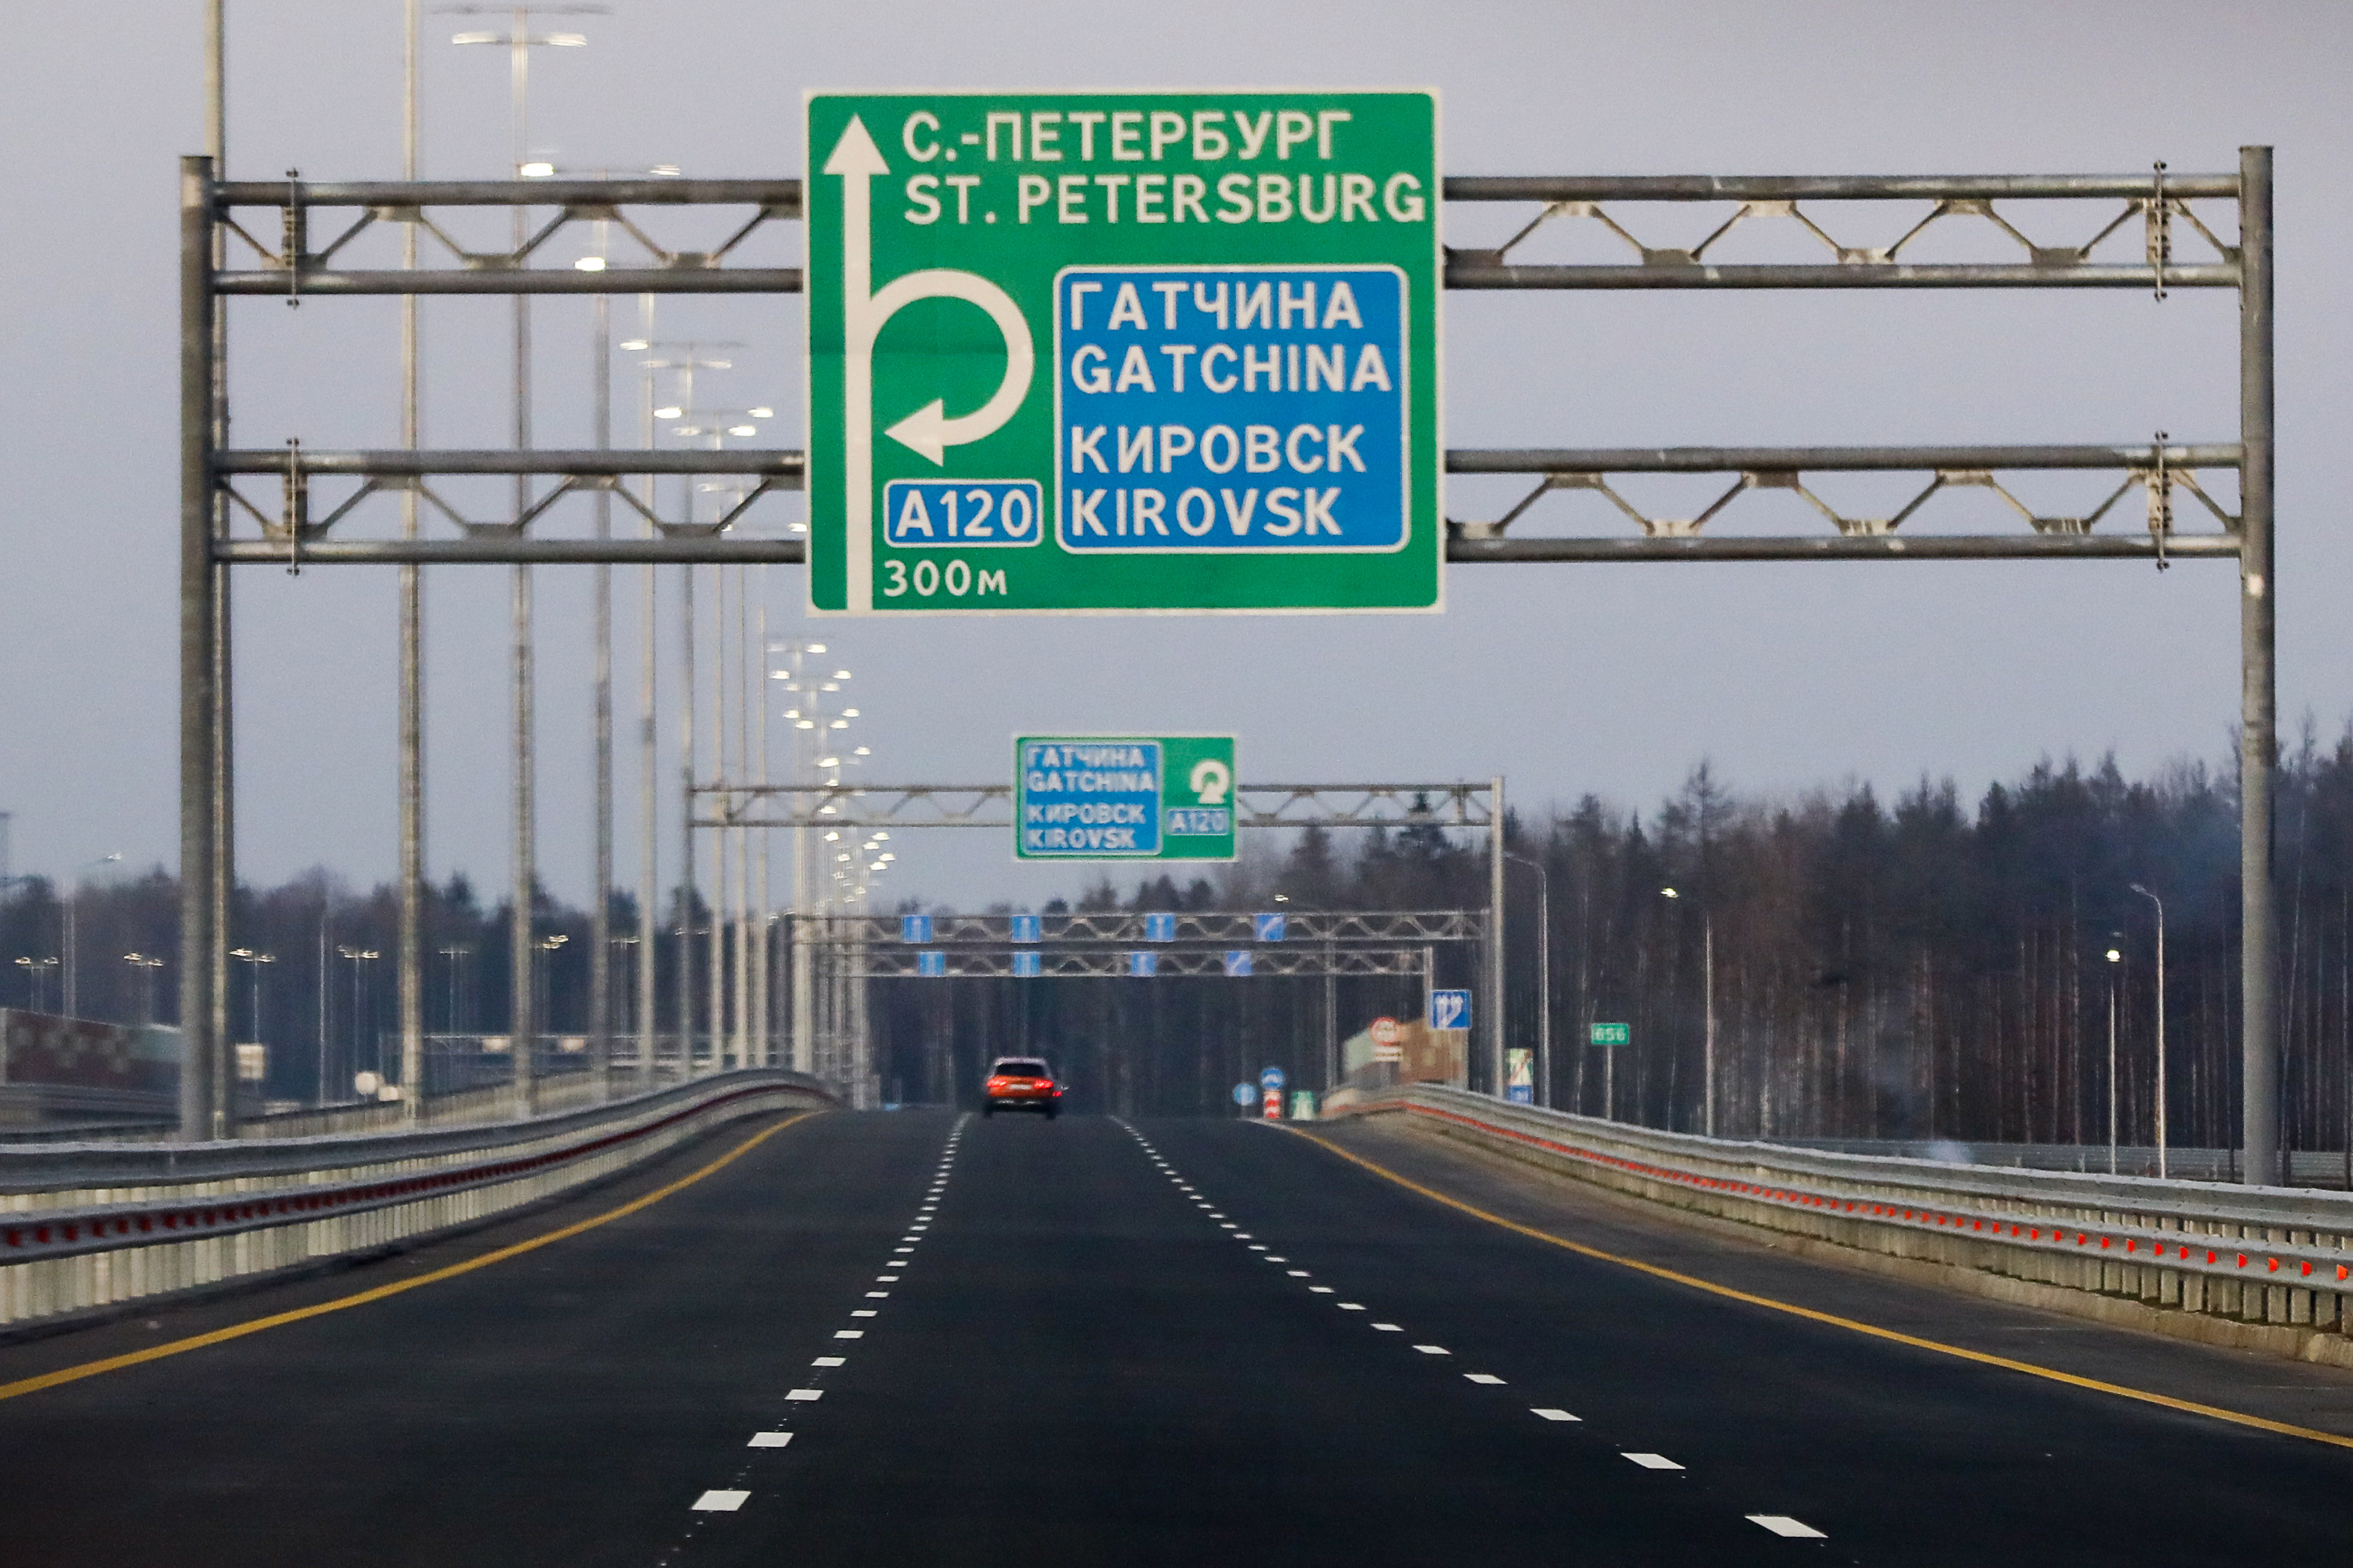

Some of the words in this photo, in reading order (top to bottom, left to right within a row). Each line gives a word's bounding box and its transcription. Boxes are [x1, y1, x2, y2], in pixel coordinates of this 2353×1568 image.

[904, 174, 996, 225] ST.
[1018, 172, 1425, 224] PETERSBURG
[1071, 281, 1363, 331] ГАТЧИНА
[1071, 343, 1392, 394] GATCHINA
[1071, 423, 1366, 474] КИРОВСК
[1072, 487, 1342, 537] KIROVSK
[1027, 746, 1145, 768] ГАТЧИНА
[1027, 770, 1155, 792] GATCHINA
[1027, 802, 1146, 824] КИРОВСК
[1027, 826, 1137, 849] KIROVSK
